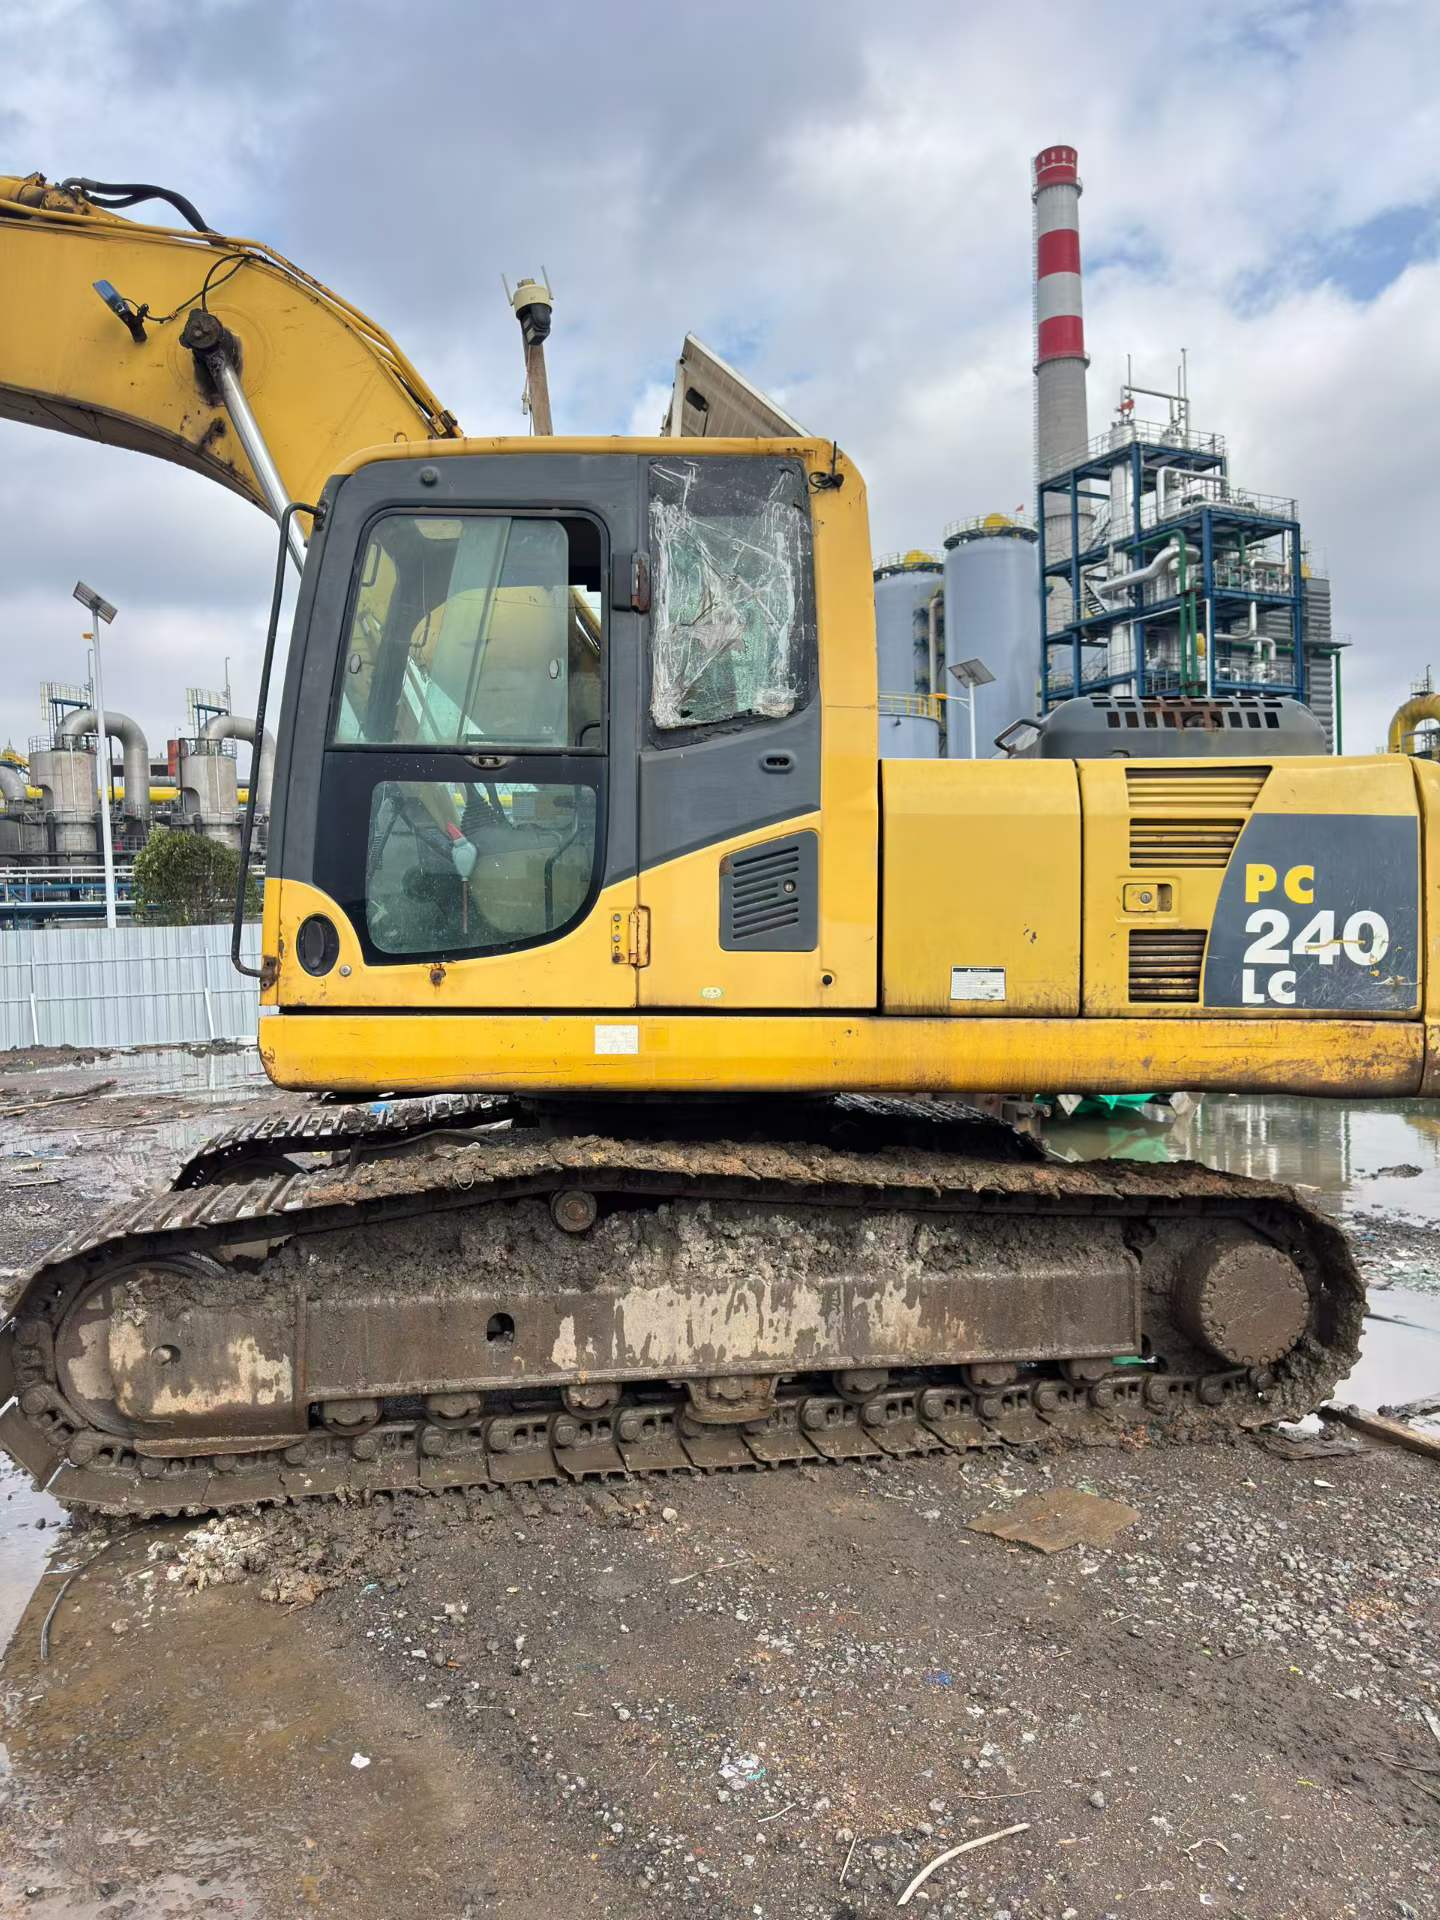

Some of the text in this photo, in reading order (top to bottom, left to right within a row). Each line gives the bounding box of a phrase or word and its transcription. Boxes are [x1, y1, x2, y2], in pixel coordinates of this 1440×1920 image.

[1245, 863, 1314, 904] PC
[1243, 908, 1389, 965] 240
[1242, 969, 1297, 1004] LC
